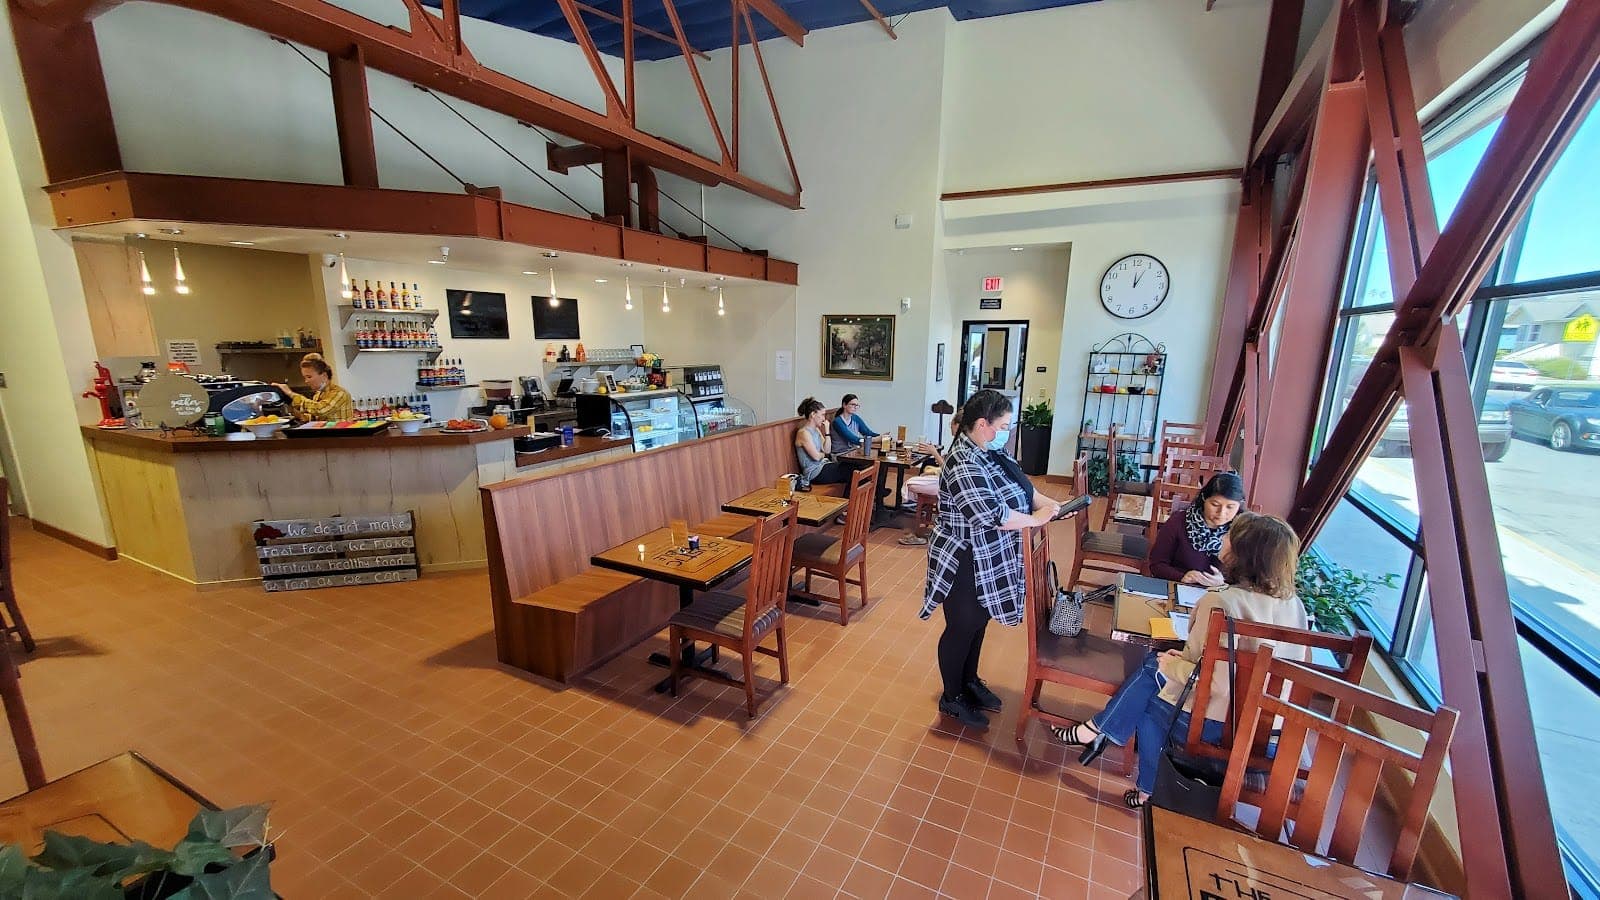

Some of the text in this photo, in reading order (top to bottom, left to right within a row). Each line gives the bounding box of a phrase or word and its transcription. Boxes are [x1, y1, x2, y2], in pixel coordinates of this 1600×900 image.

[1119, 263, 1128, 271] 11
[1132, 259, 1143, 267] 12
[1108, 272, 1118, 280] 10
[985, 278, 1001, 290] EXIT
[1158, 282, 1164, 290] 3
[1116, 304, 1122, 312] 7
[286, 517, 405, 537] We do not make
[328, 557, 370, 570] healthy
[375, 556, 404, 568] food
[343, 574, 362, 584] we
